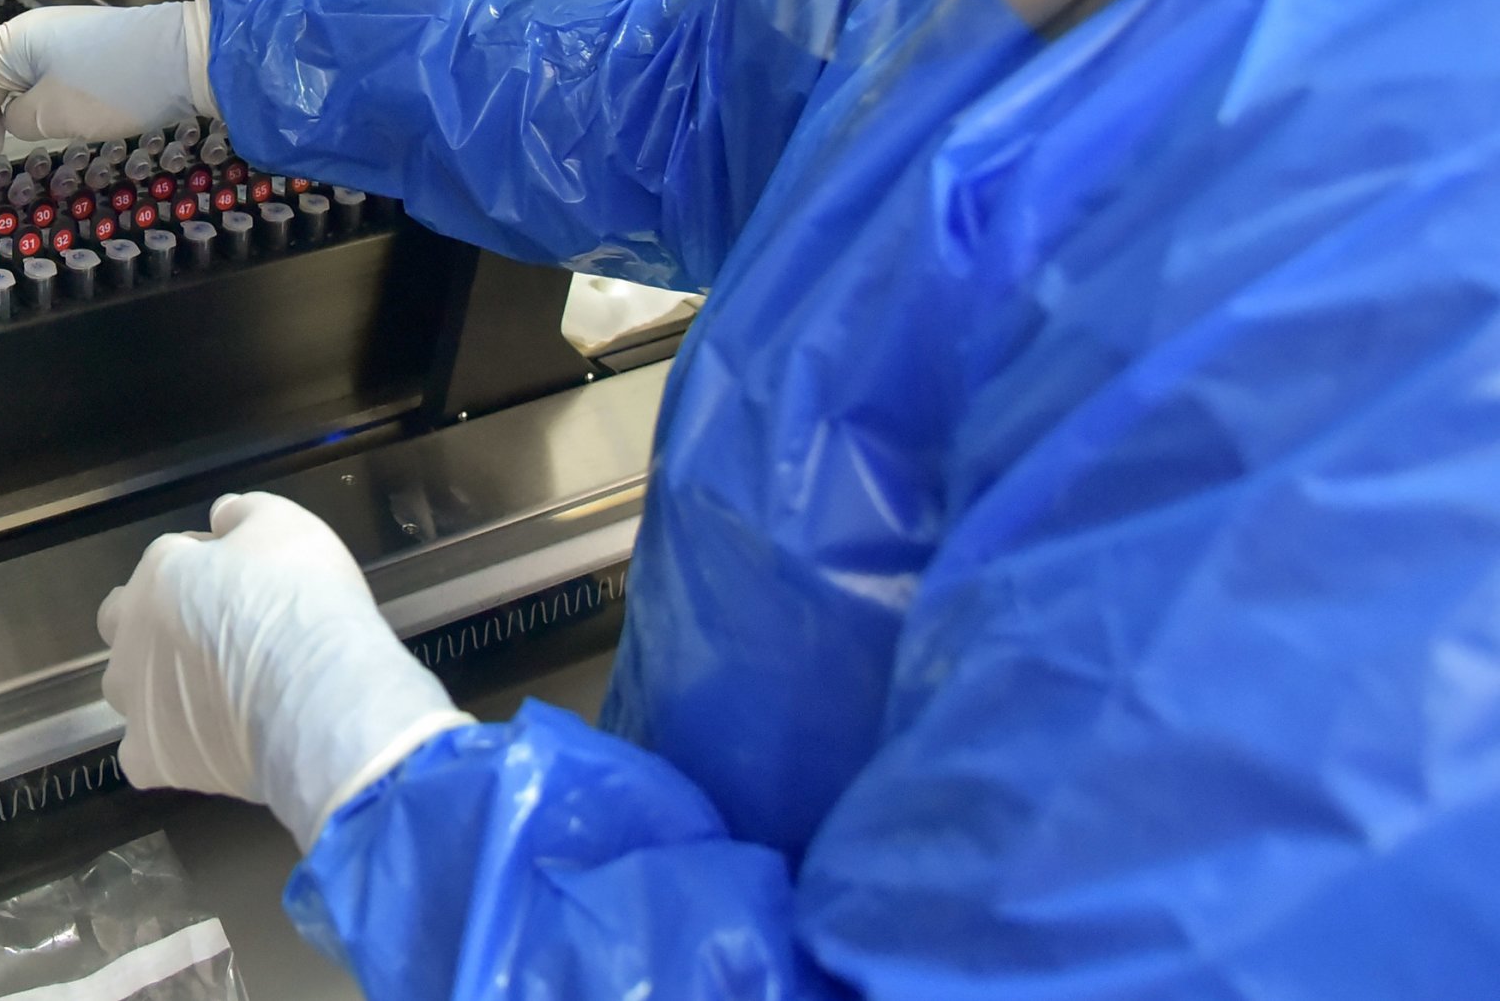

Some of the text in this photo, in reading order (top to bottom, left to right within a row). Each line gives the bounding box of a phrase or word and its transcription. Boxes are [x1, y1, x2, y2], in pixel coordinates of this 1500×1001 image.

[192, 176, 206, 186] 46
[155, 183, 169, 194] 45
[255, 185, 267, 197] 55
[116, 195, 129, 206] 38
[218, 194, 231, 205] 48
[75, 202, 88, 214] 37
[179, 203, 192, 215] 47
[37, 210, 50, 222] 30
[138, 210, 151, 222] 40
[0, 218, 13, 230] 29
[98, 222, 111, 236] 39
[22, 239, 35, 250] 31
[57, 234, 69, 247] 32
